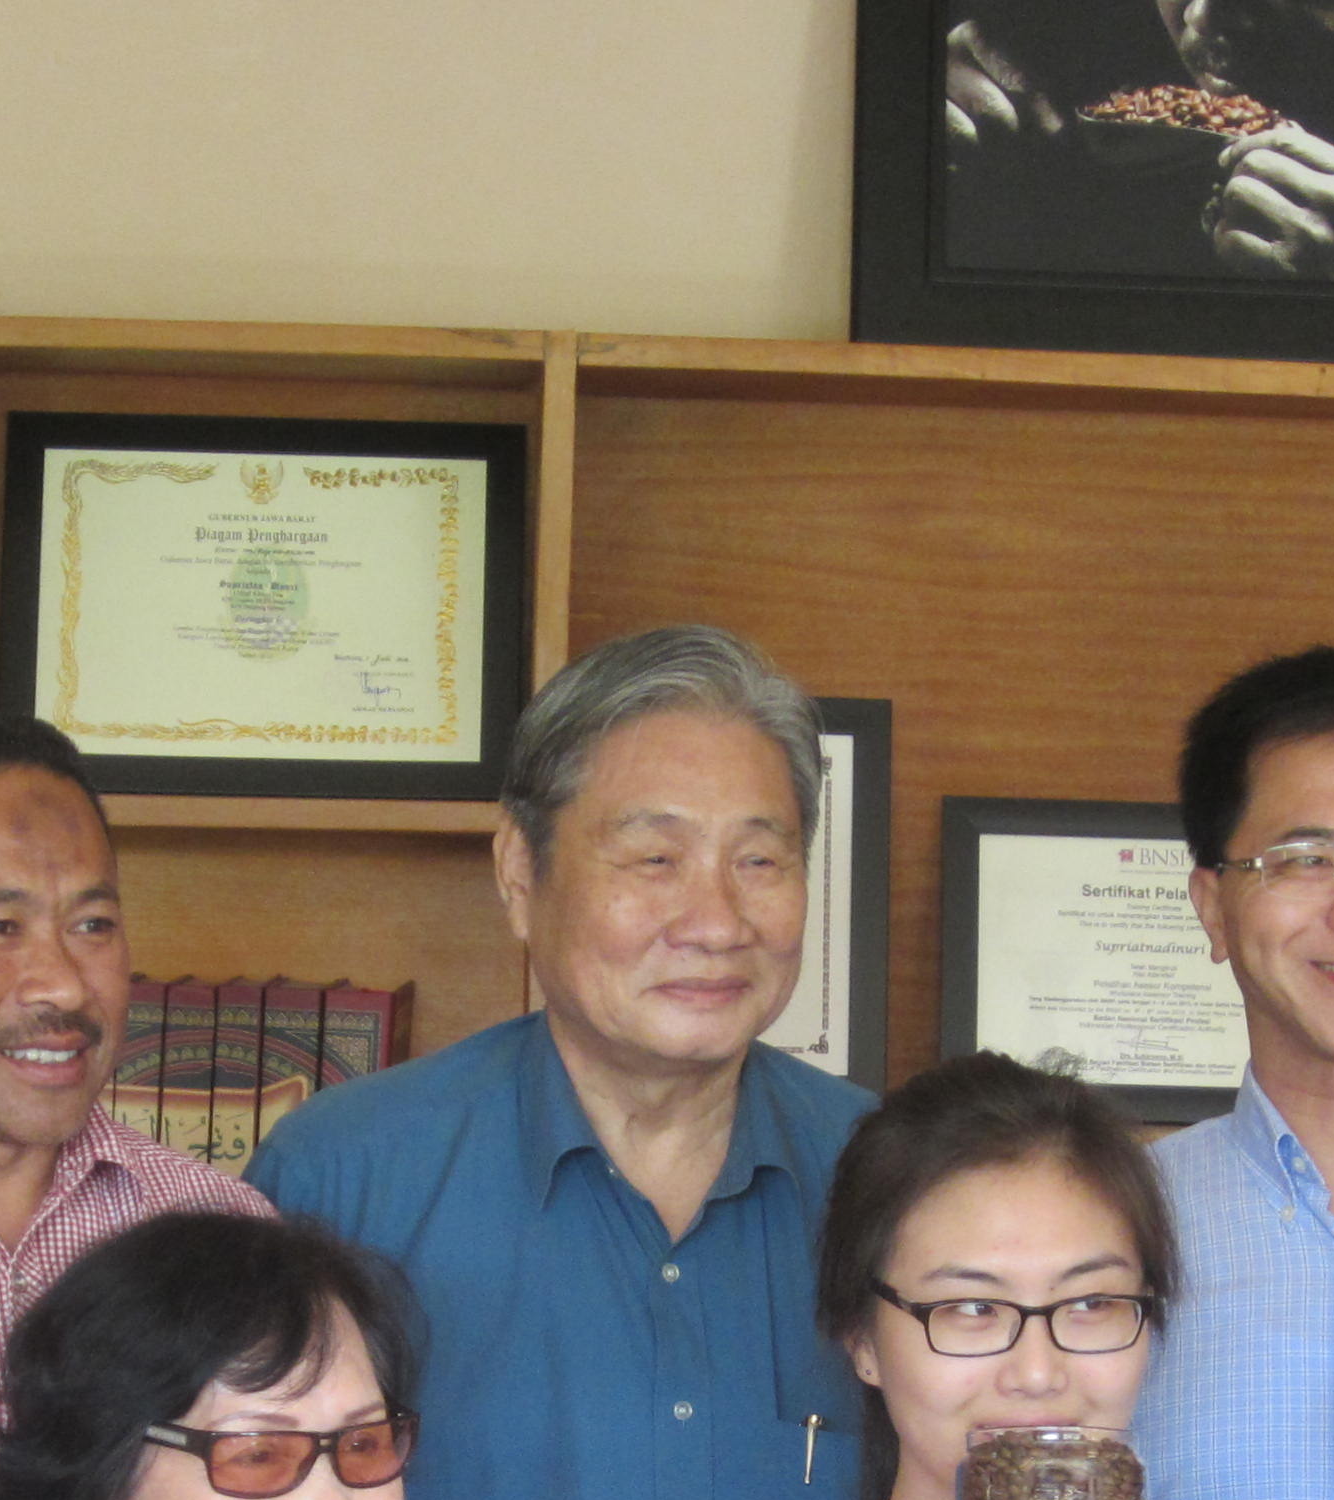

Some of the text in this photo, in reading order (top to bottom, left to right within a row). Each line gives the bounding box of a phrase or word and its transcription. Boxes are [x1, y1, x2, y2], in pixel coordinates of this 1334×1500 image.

[194, 526, 329, 545] Piagam Penghargaan
[1082, 884, 1188, 900] Sertifikat Pela
[1094, 940, 1205, 956] Supriatnadinuri
